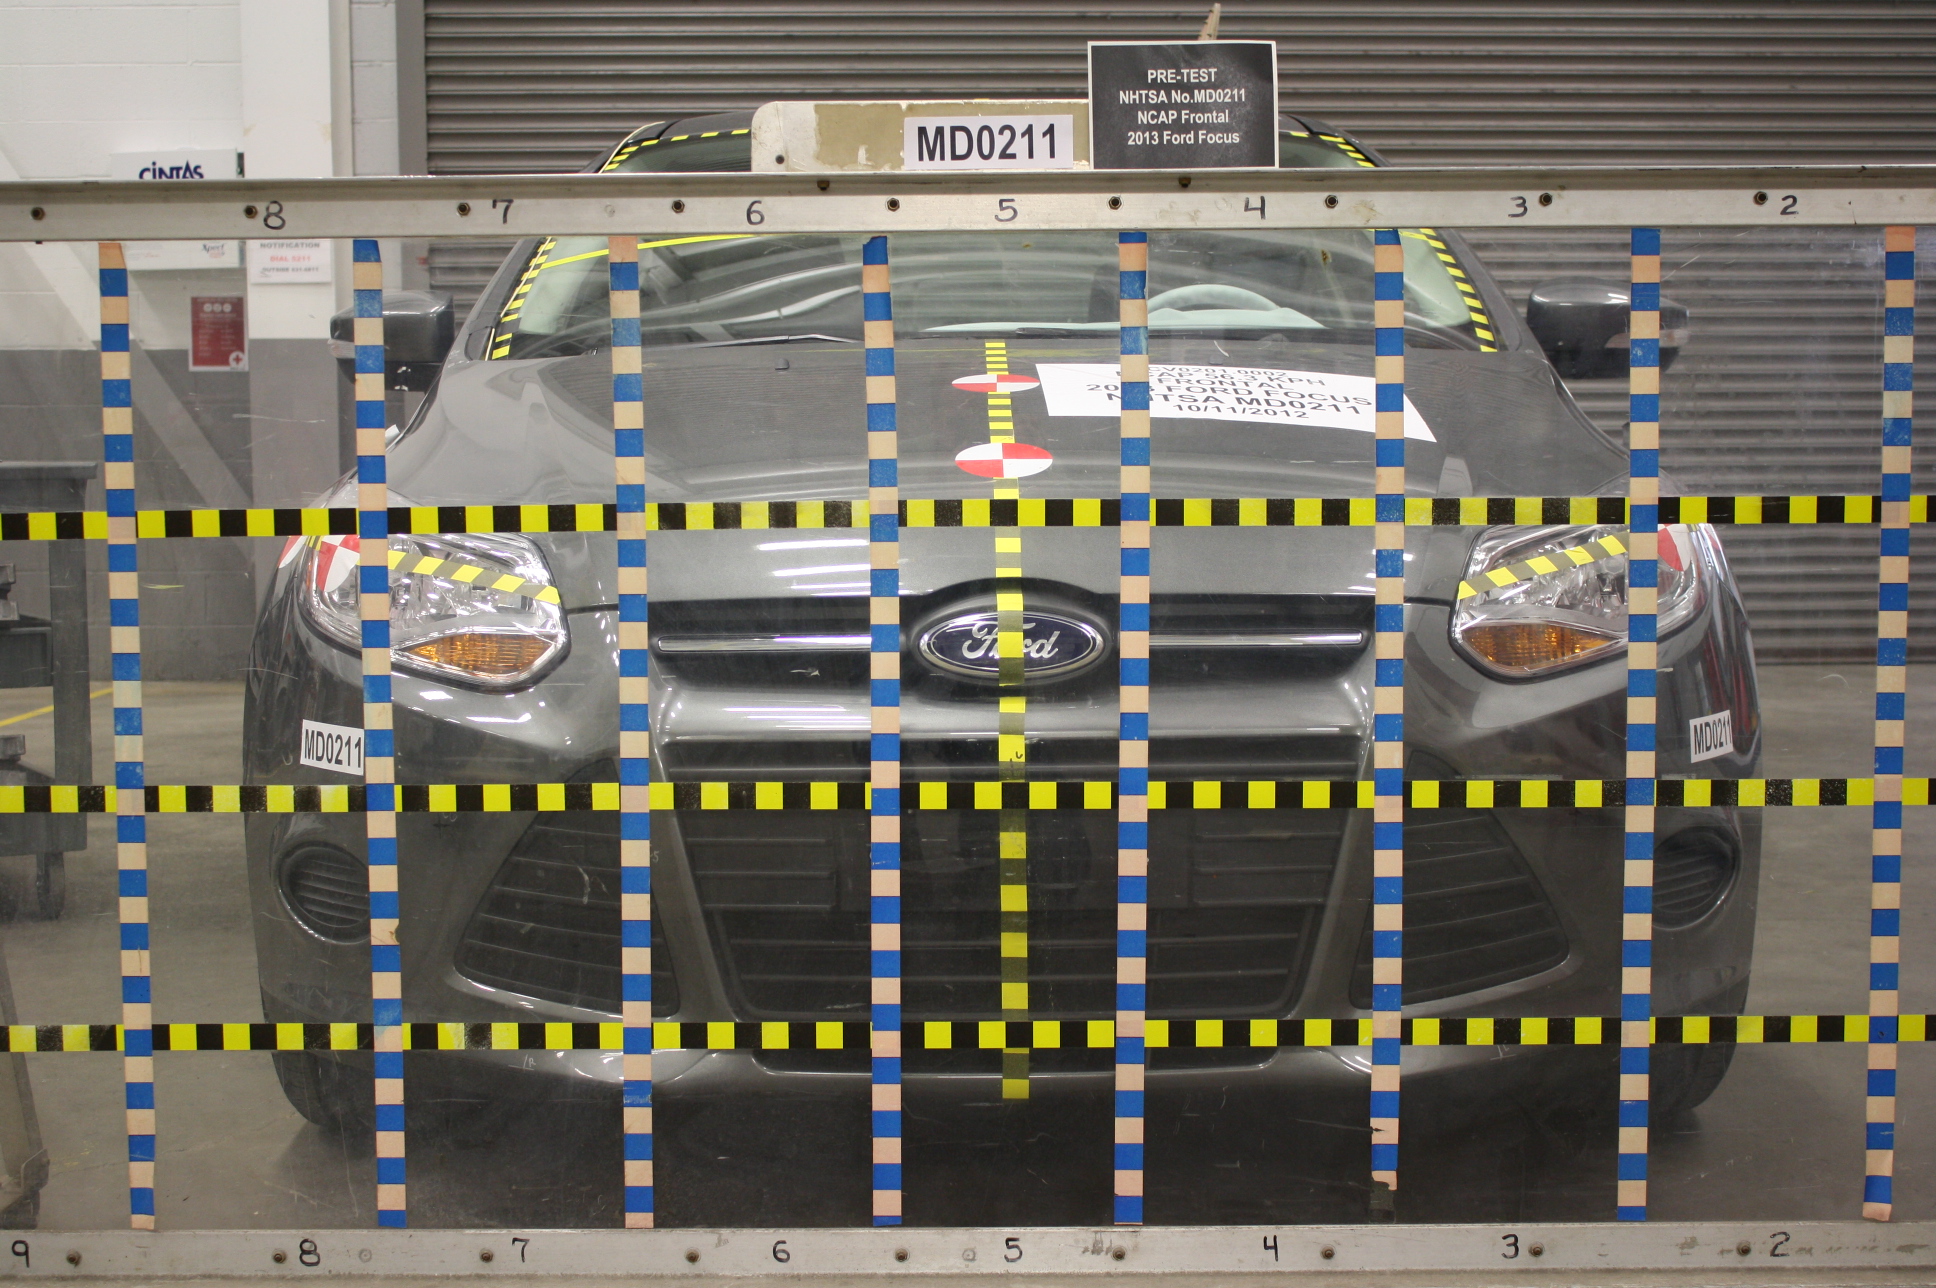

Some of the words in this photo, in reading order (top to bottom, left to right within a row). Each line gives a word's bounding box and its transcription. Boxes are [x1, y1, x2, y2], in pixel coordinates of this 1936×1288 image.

[1148, 68, 1218, 83] PRE-TEST
[1119, 90, 1168, 104] NHTSA
[1171, 88, 1245, 103] No.MD0211
[1137, 110, 1178, 124] NCAP
[1181, 109, 1229, 124] Frontal
[917, 124, 1056, 161] MD0211
[1127, 131, 1159, 145] 2013
[1163, 130, 1194, 144] Ford
[1198, 130, 1240, 144] Focus
[263, 200, 286, 230] 8
[492, 198, 514, 224] 7
[746, 199, 766, 225] 6
[994, 198, 1018, 223] 5
[1243, 195, 1266, 220] 4
[1507, 196, 1528, 218] 3
[1780, 195, 1799, 216] 2
[1157, 378, 1294, 390] FRONTAL
[1205, 373, 1258, 381] 56.3
[1267, 376, 1326, 386] KPH
[1166, 385, 1253, 396] FORD
[1264, 389, 1373, 405] FOCUS
[1173, 404, 1309, 418] 10/11/2012
[1235, 397, 1361, 415] MD0211
[1693, 714, 1732, 755] MD0211
[304, 729, 362, 768] MD0211
[11, 1239, 30, 1268] 9
[298, 1238, 321, 1267] 8
[511, 1237, 530, 1263] 7
[772, 1239, 791, 1264] 6
[1003, 1237, 1023, 1263] 5
[1263, 1234, 1280, 1262] 4
[1501, 1233, 1520, 1259] 3
[1769, 1231, 1791, 1258] 2
